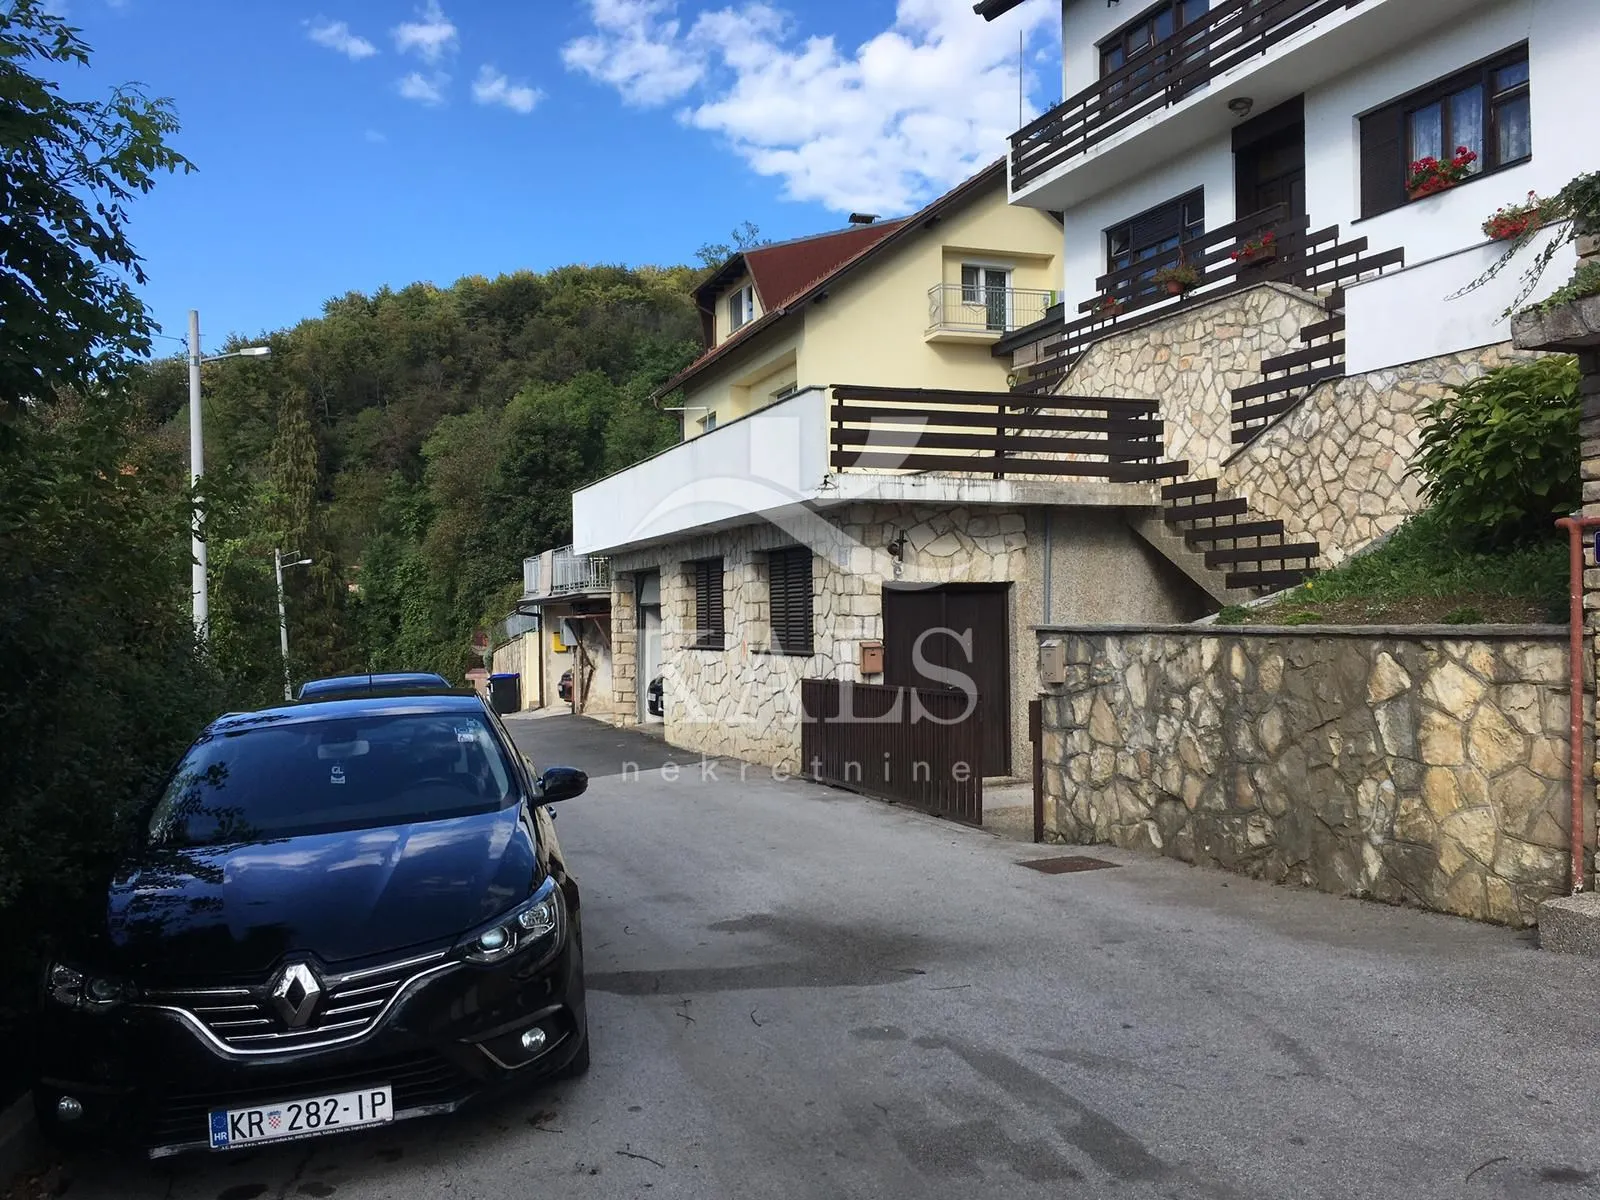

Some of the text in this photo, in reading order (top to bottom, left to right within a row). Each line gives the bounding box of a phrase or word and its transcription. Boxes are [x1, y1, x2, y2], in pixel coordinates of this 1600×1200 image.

[230, 1110, 265, 1140] KR
[286, 1091, 386, 1131] 282-IP
[213, 1131, 228, 1141] HR
